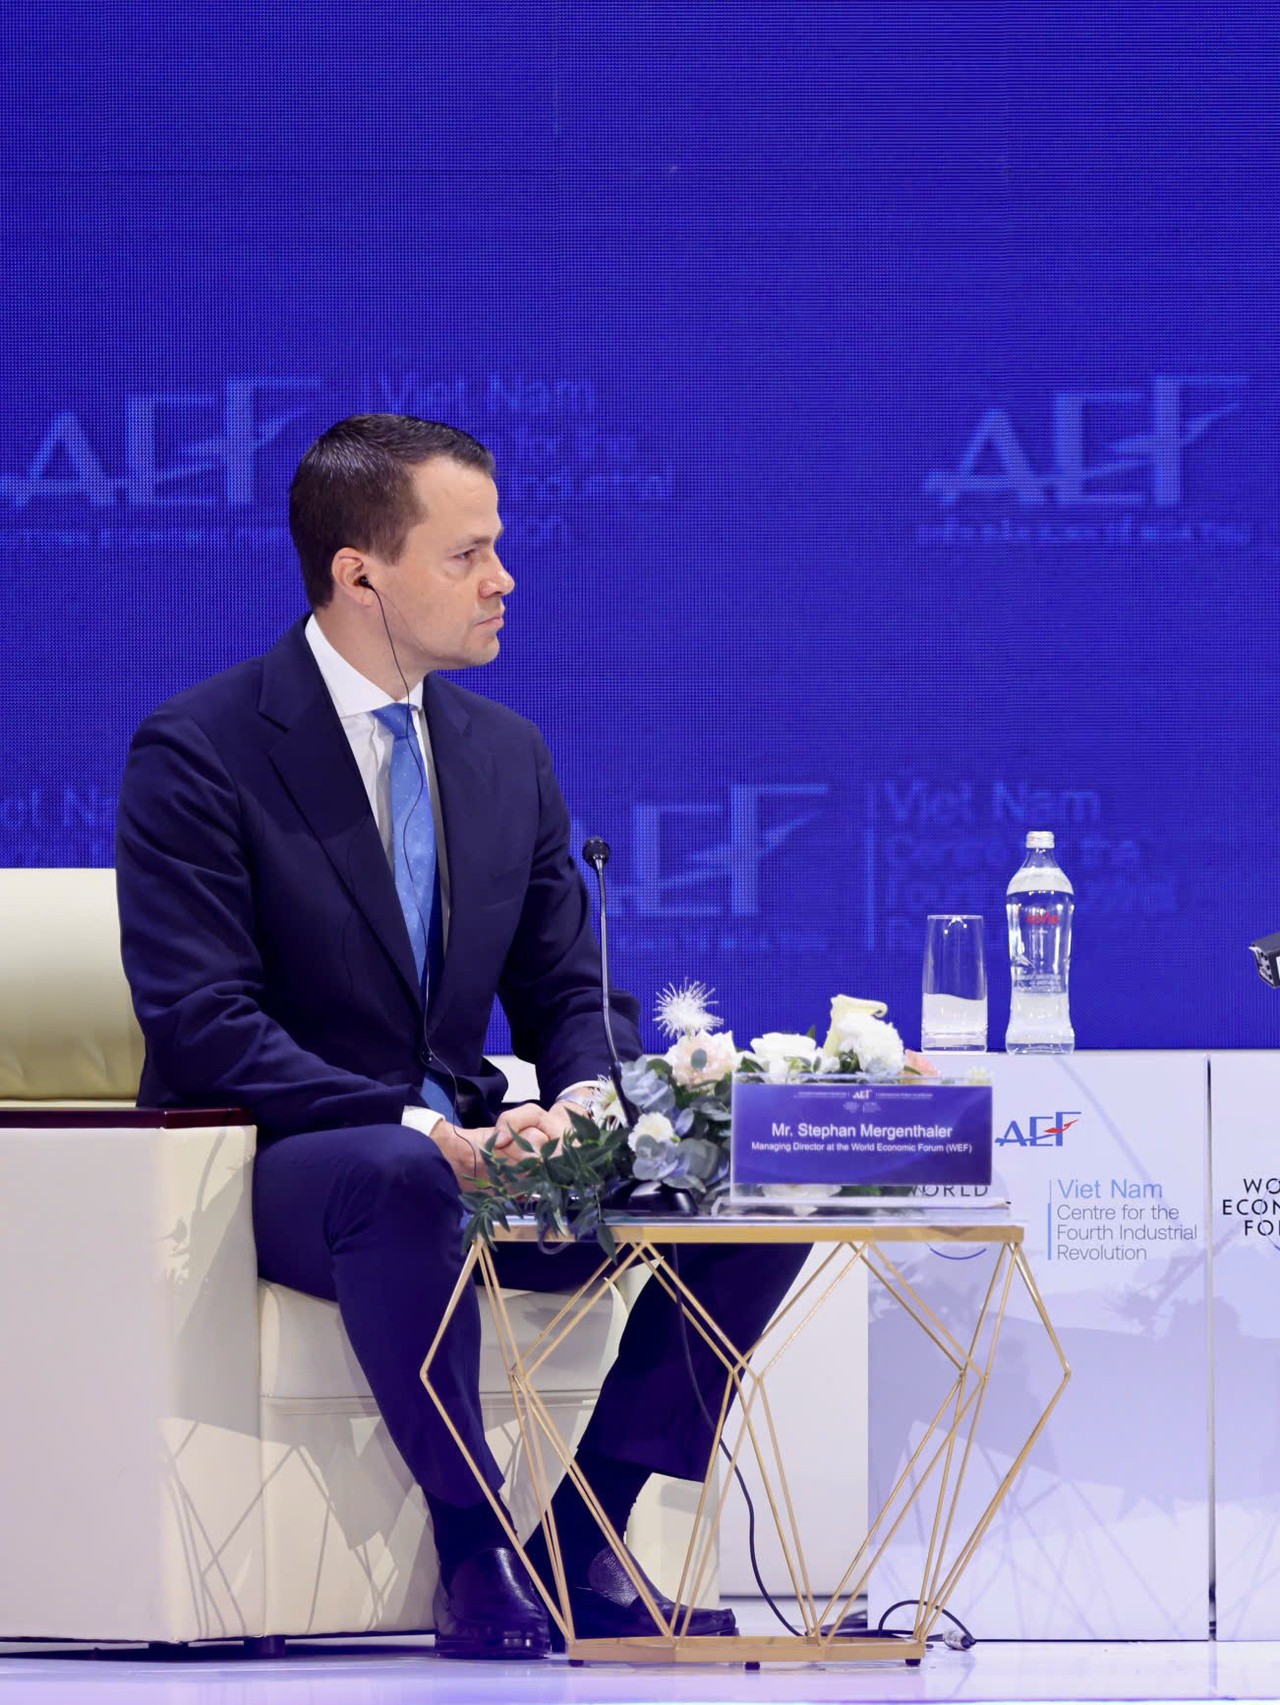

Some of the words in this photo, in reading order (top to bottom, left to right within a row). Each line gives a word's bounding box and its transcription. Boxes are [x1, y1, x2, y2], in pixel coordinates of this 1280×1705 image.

[0, 375, 323, 507] AEF
[922, 373, 1251, 507] AEF
[772, 1122, 793, 1137] Mr.
[798, 1123, 856, 1140] Stephan
[860, 1123, 953, 1141] Mergenthaler
[994, 1111, 1082, 1147] AEF
[751, 1141, 792, 1153] Managing
[793, 1142, 824, 1152] Director
[826, 1143, 835, 1152] at
[836, 1142, 850, 1152] the
[851, 1142, 875, 1152] World
[877, 1143, 916, 1153] Economic
[918, 1143, 944, 1153] Forum
[946, 1143, 973, 1155] (WEF)
[1057, 1179, 1101, 1199] Viet
[1111, 1179, 1163, 1199] Nam
[1057, 1204, 1116, 1220] Centre
[1122, 1204, 1145, 1220] for
[1151, 1204, 1180, 1220] the
[1057, 1225, 1113, 1241] Fourth
[1119, 1224, 1198, 1241] Industrial
[1057, 1244, 1147, 1261] Revolution
